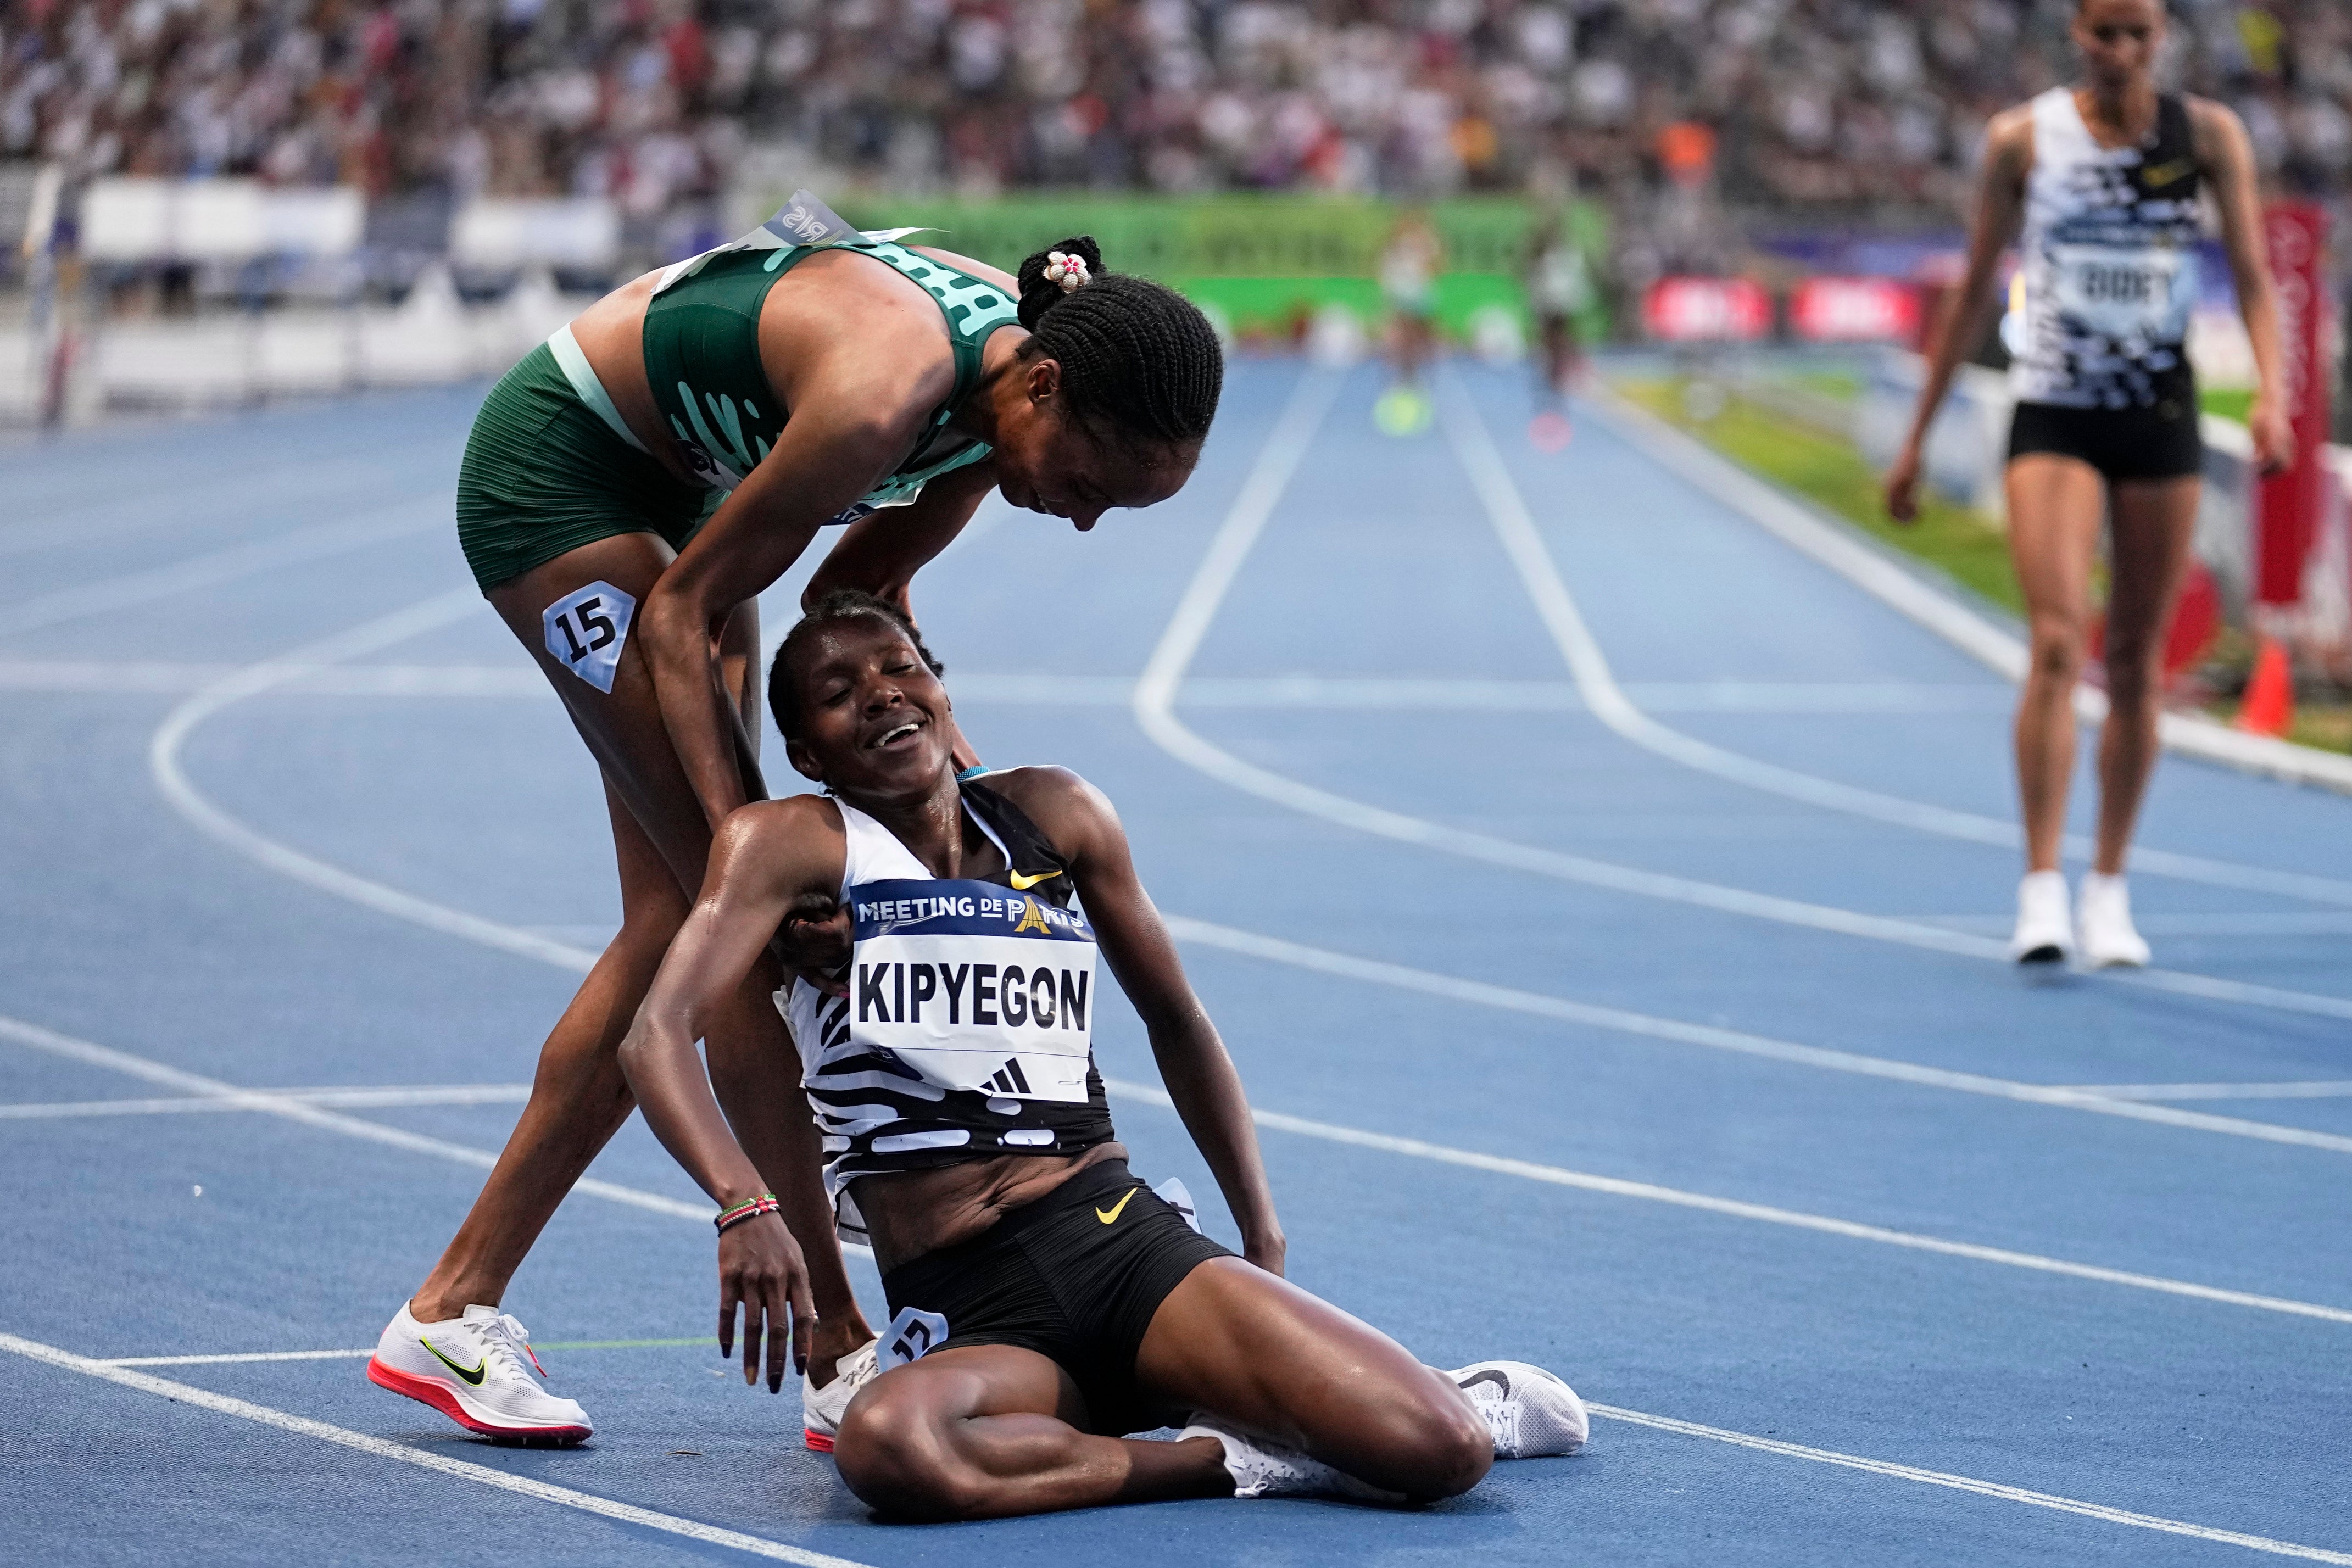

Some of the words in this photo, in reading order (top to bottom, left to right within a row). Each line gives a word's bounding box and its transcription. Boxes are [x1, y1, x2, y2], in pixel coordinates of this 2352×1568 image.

[555, 596, 616, 664] 15
[858, 896, 976, 922] MEETING
[981, 898, 1003, 918] DE
[859, 962, 1089, 1031] KIPYEGON
